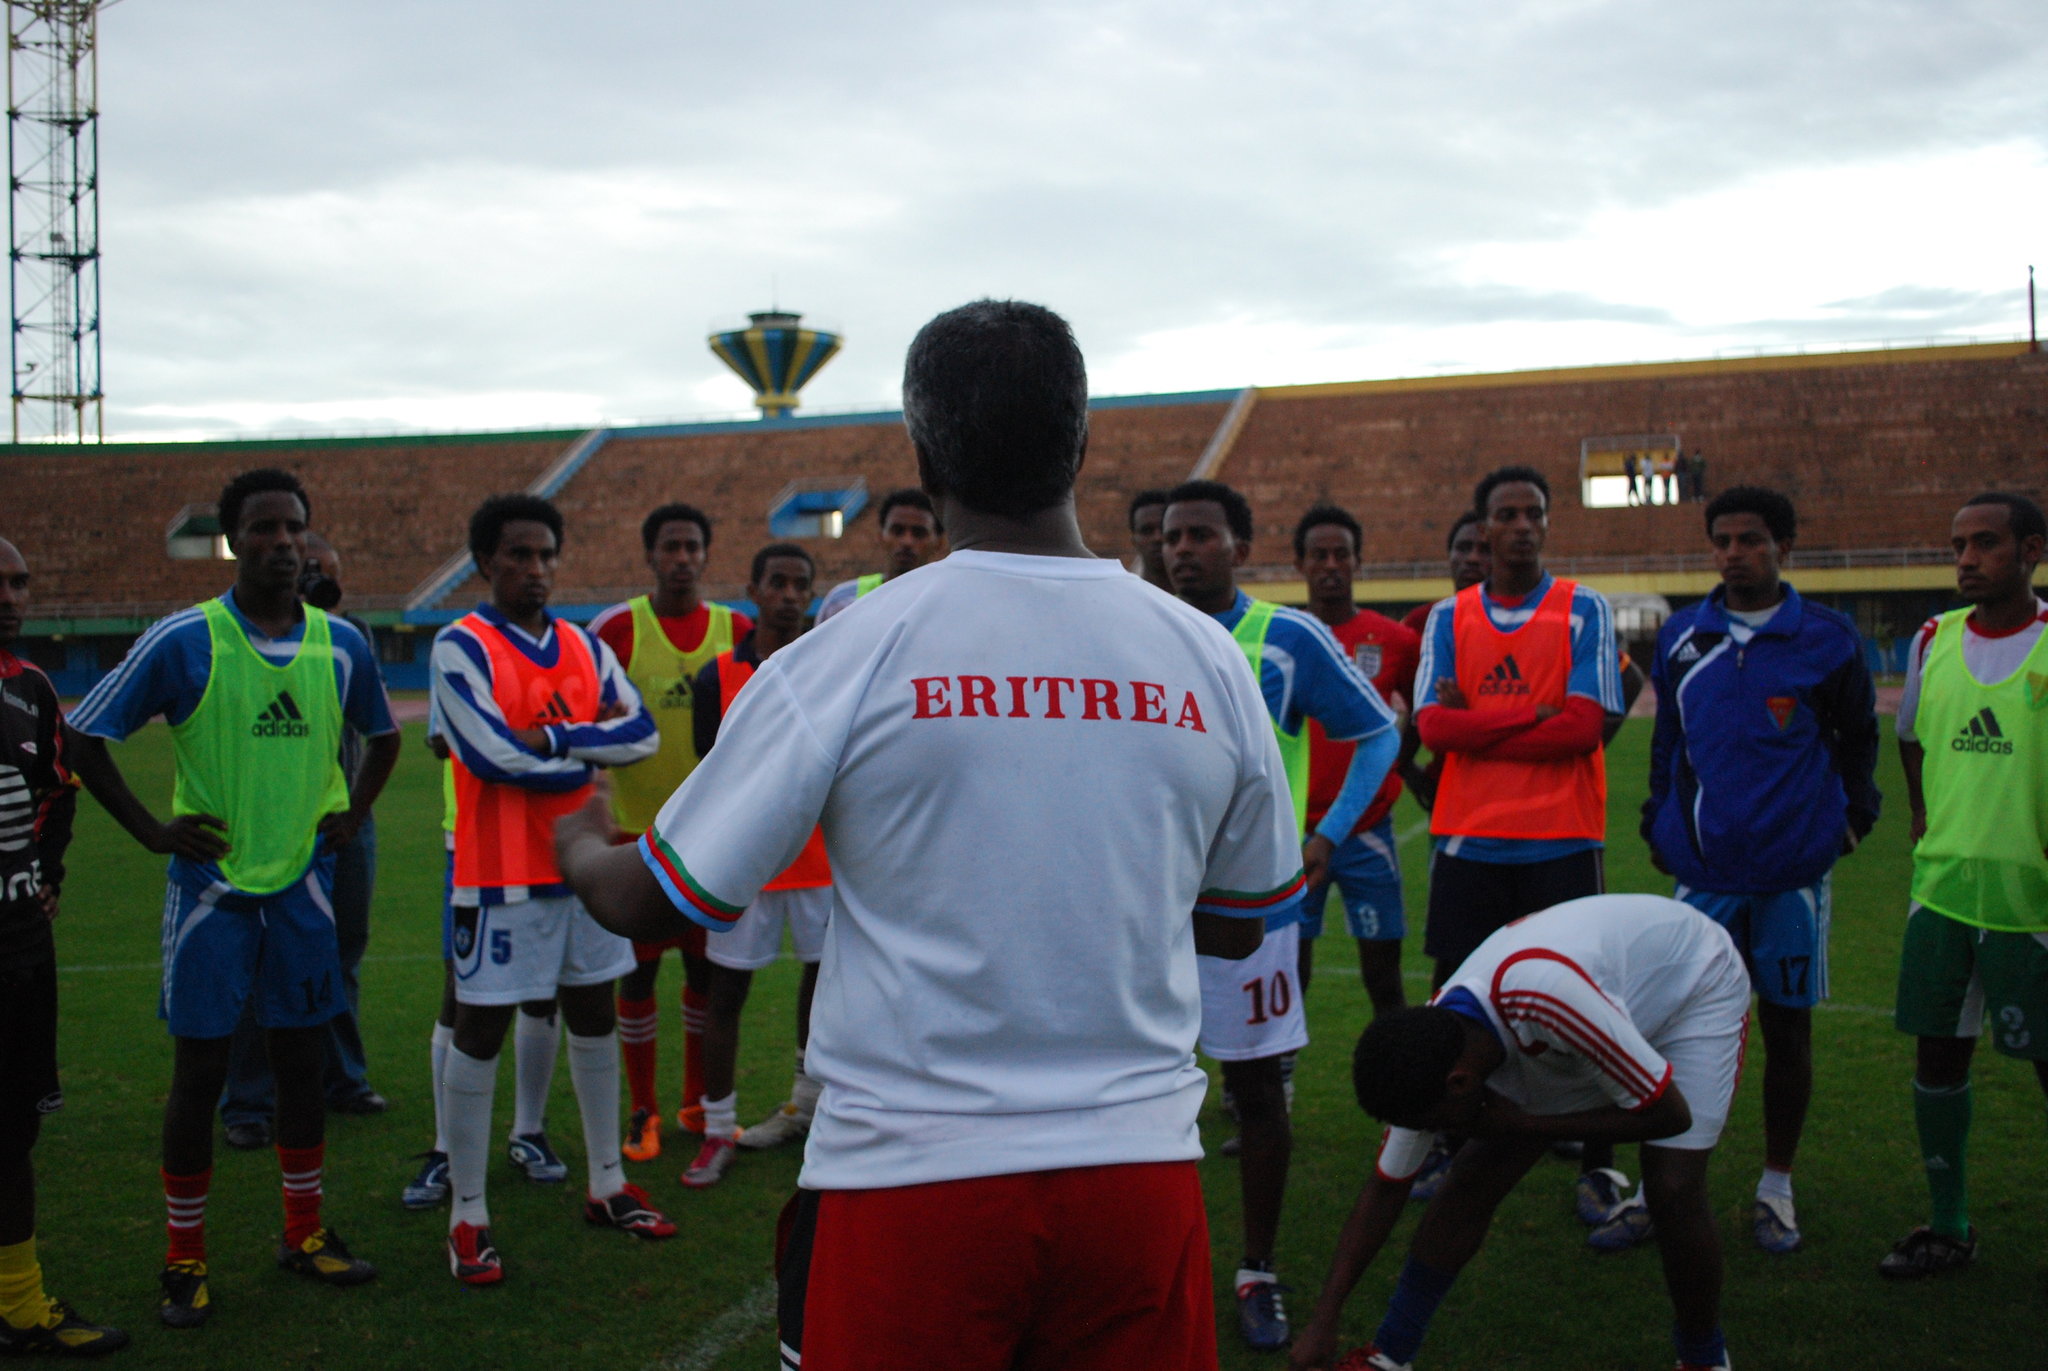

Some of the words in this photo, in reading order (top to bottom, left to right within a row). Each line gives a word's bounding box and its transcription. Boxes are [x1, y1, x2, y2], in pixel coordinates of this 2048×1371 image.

[910, 675, 1206, 733] ERITREA
[1478, 681, 1531, 697] adidas
[251, 721, 309, 737] adidas
[1951, 736, 2013, 755] adidas
[0, 858, 42, 902] nt
[491, 930, 511, 965] 5
[1778, 956, 1809, 995] 17
[1243, 970, 1290, 1025] 10
[2001, 1006, 2030, 1049] 3
